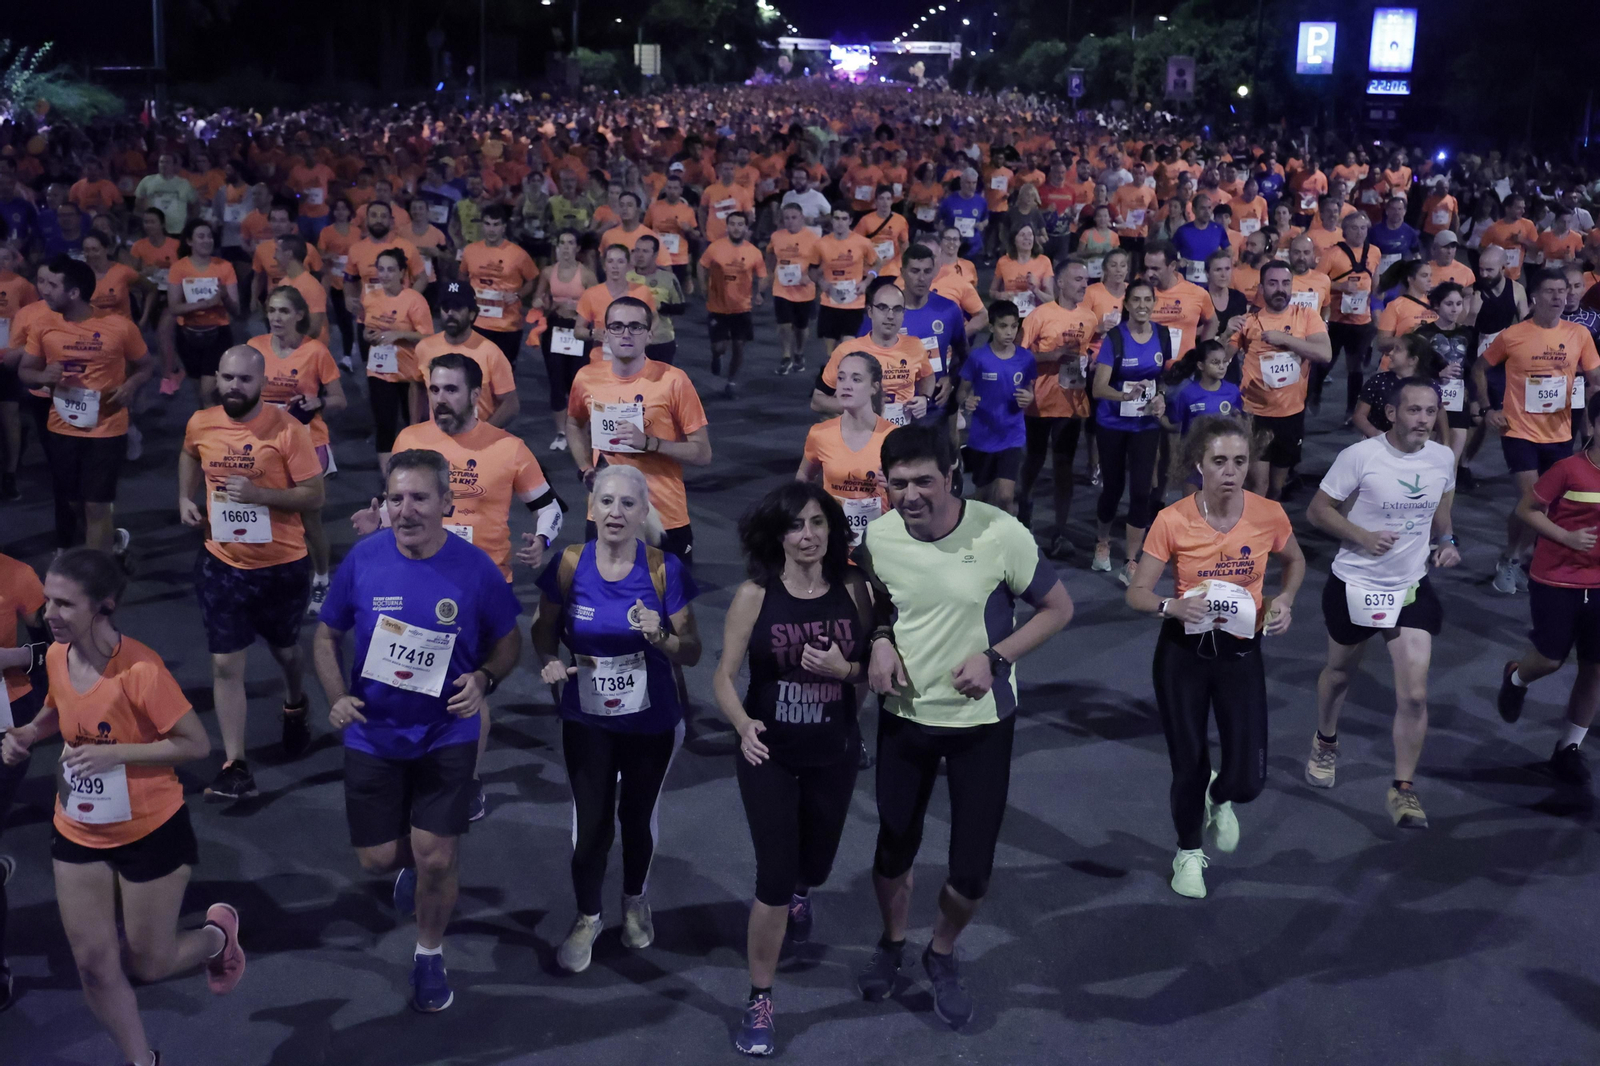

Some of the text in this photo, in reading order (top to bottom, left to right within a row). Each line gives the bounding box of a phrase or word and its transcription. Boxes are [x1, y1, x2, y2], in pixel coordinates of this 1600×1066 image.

[1307, 27, 1329, 57] P
[1369, 80, 1408, 92] 22:06
[1270, 363, 1294, 374] 12411
[1538, 390, 1559, 399] 5364
[65, 398, 87, 411] 9780
[603, 419, 618, 431] 98
[209, 461, 237, 469] SEVILLA
[831, 484, 859, 492] SEVILLA
[843, 480, 877, 488] NOCTURNA
[222, 511, 257, 523] 16603
[847, 515, 868, 526] 836
[1215, 560, 1255, 568] NOCTURNA
[1197, 569, 1233, 577] SEVILLA
[1365, 594, 1394, 606] 6379
[771, 619, 852, 647] SWEAT
[389, 642, 435, 667] 17418
[772, 641, 855, 668] TOY
[592, 674, 635, 692] 17384
[775, 701, 830, 724] ROW.
[71, 775, 104, 794] 5299
